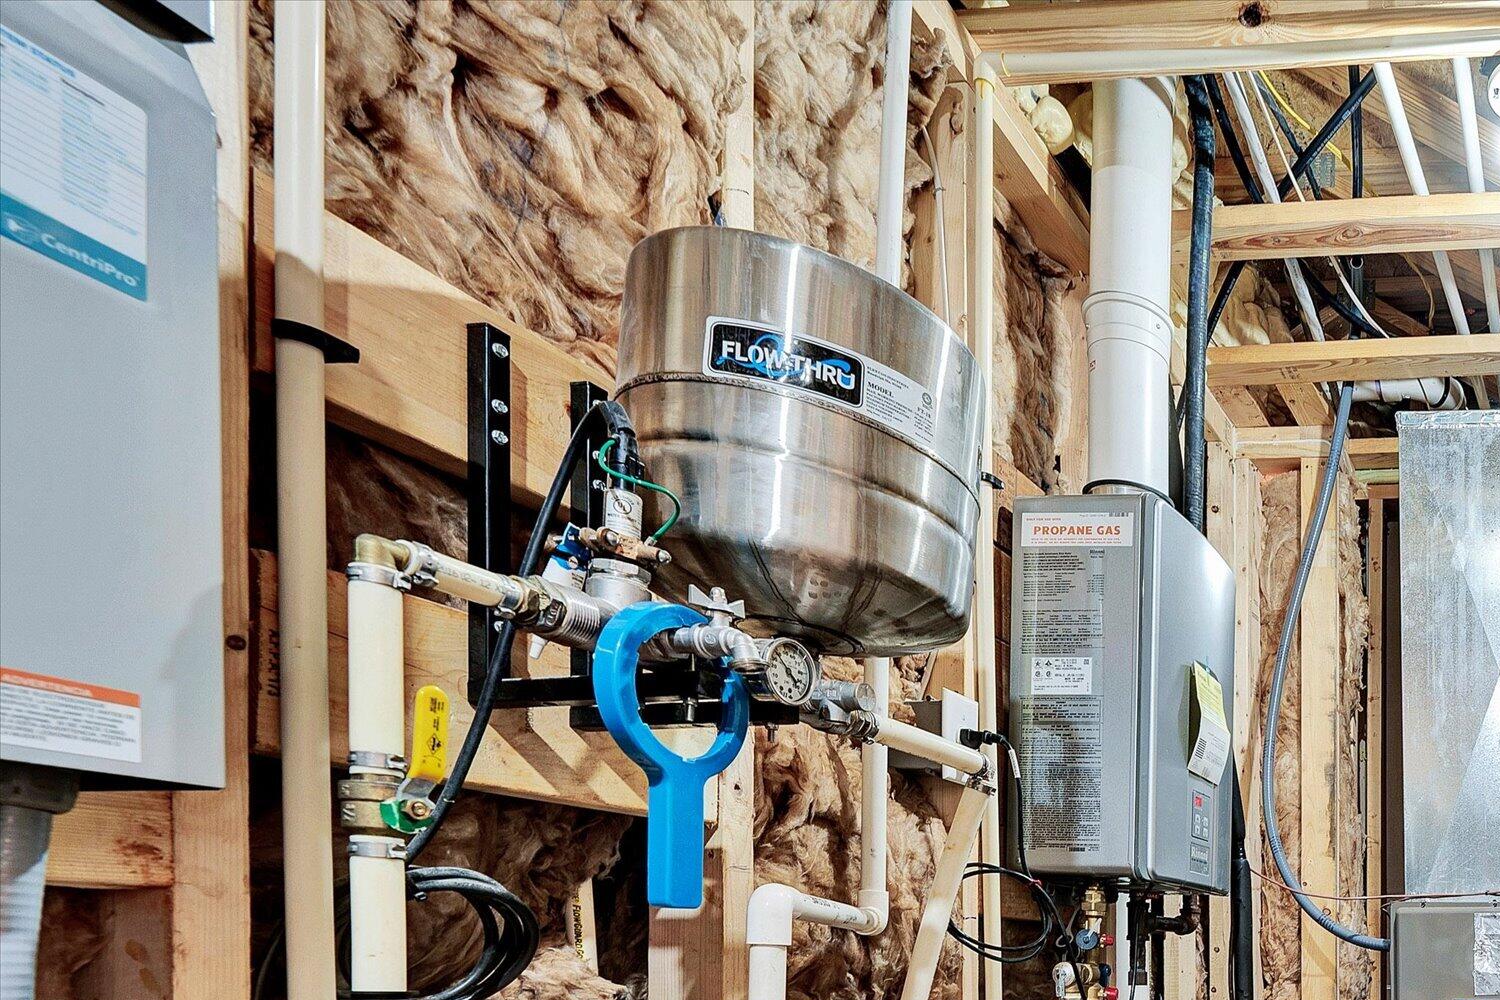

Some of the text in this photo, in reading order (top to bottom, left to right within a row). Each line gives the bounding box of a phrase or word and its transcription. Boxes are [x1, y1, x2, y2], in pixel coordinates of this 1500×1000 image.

[41, 232, 138, 288] CentriPro
[1033, 525, 1121, 535] PROPANE GAS
